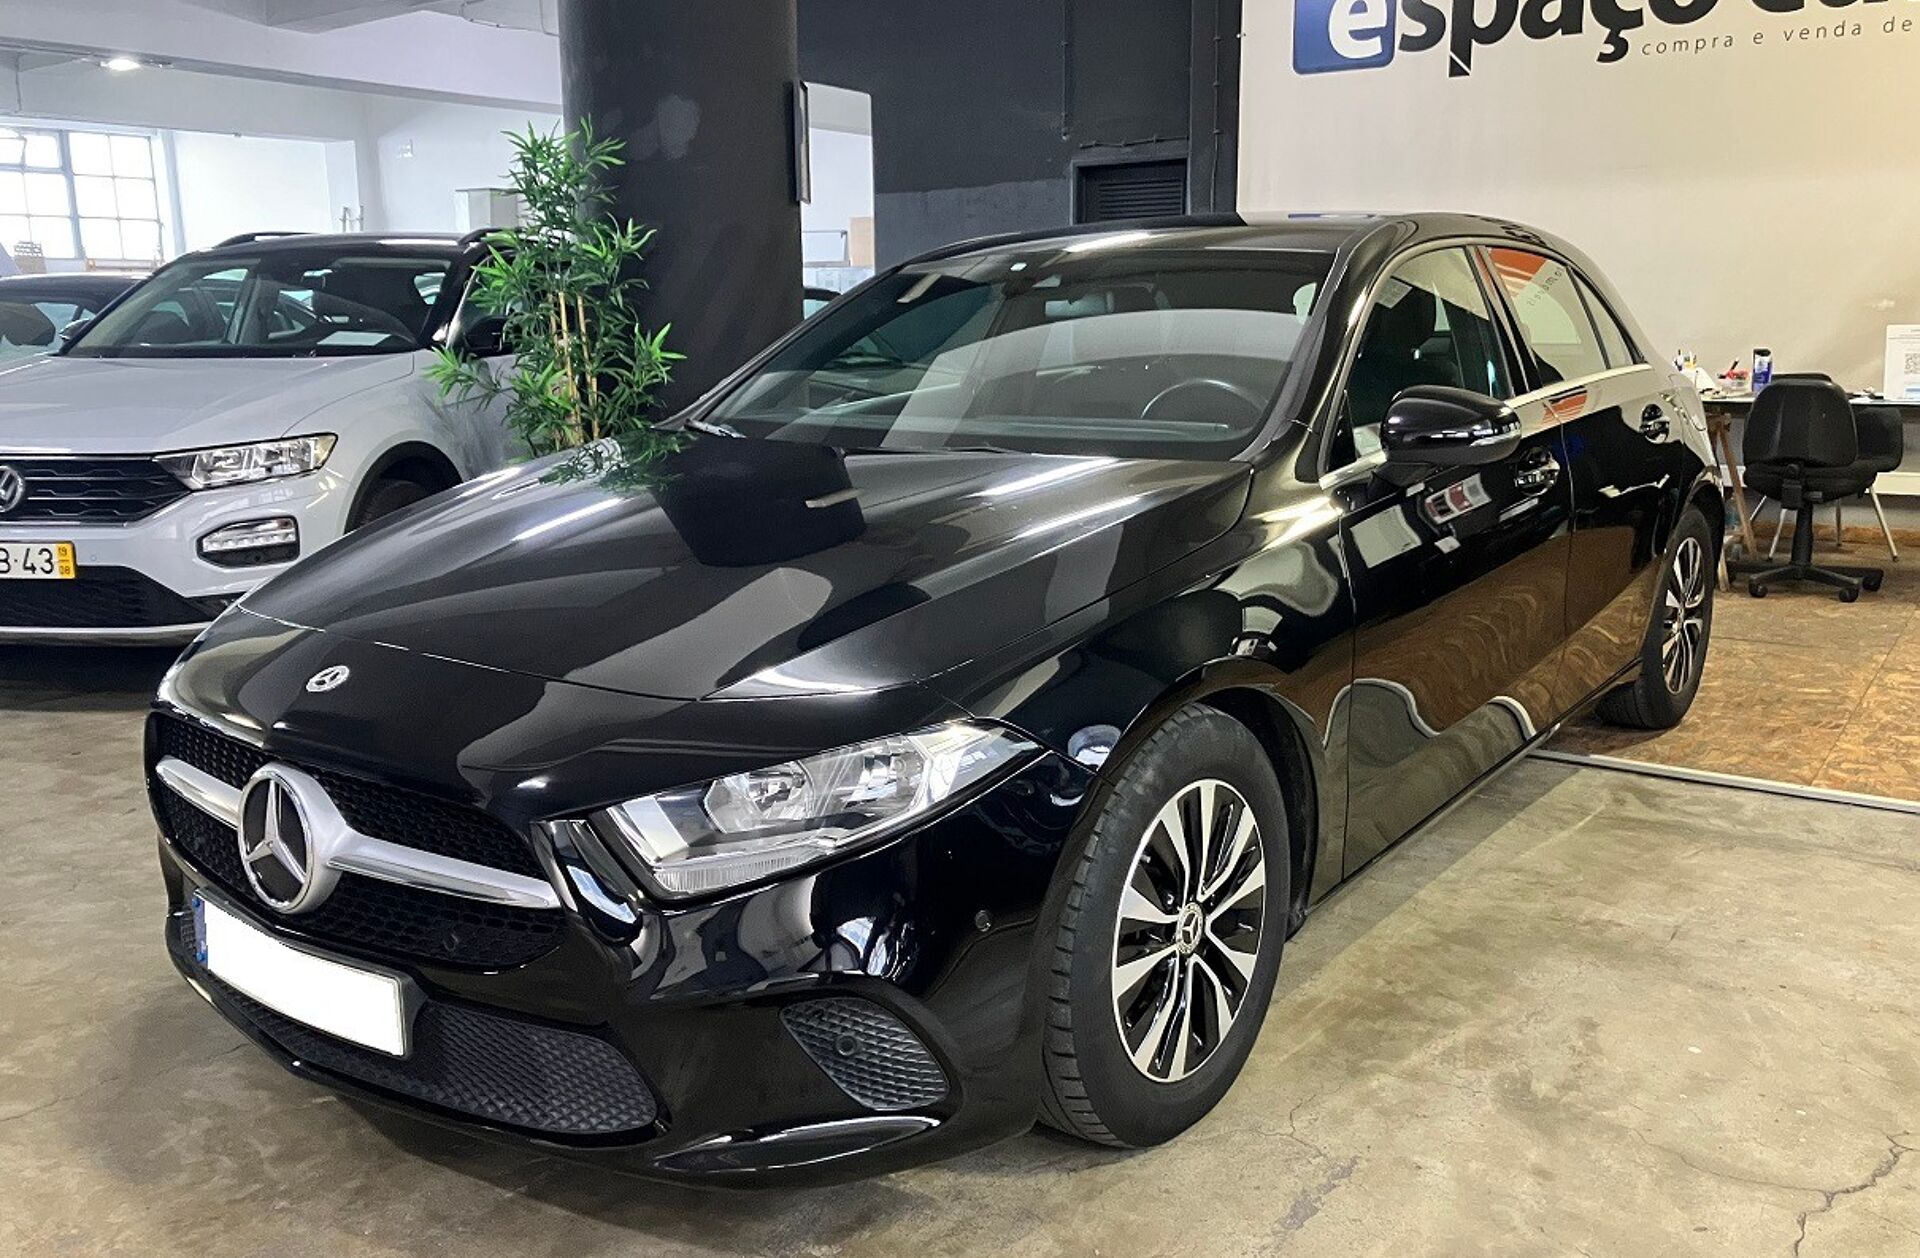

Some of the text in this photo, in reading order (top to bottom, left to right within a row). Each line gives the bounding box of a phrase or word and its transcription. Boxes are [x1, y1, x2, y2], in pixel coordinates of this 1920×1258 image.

[1641, 16, 1913, 55] compra e venda de
